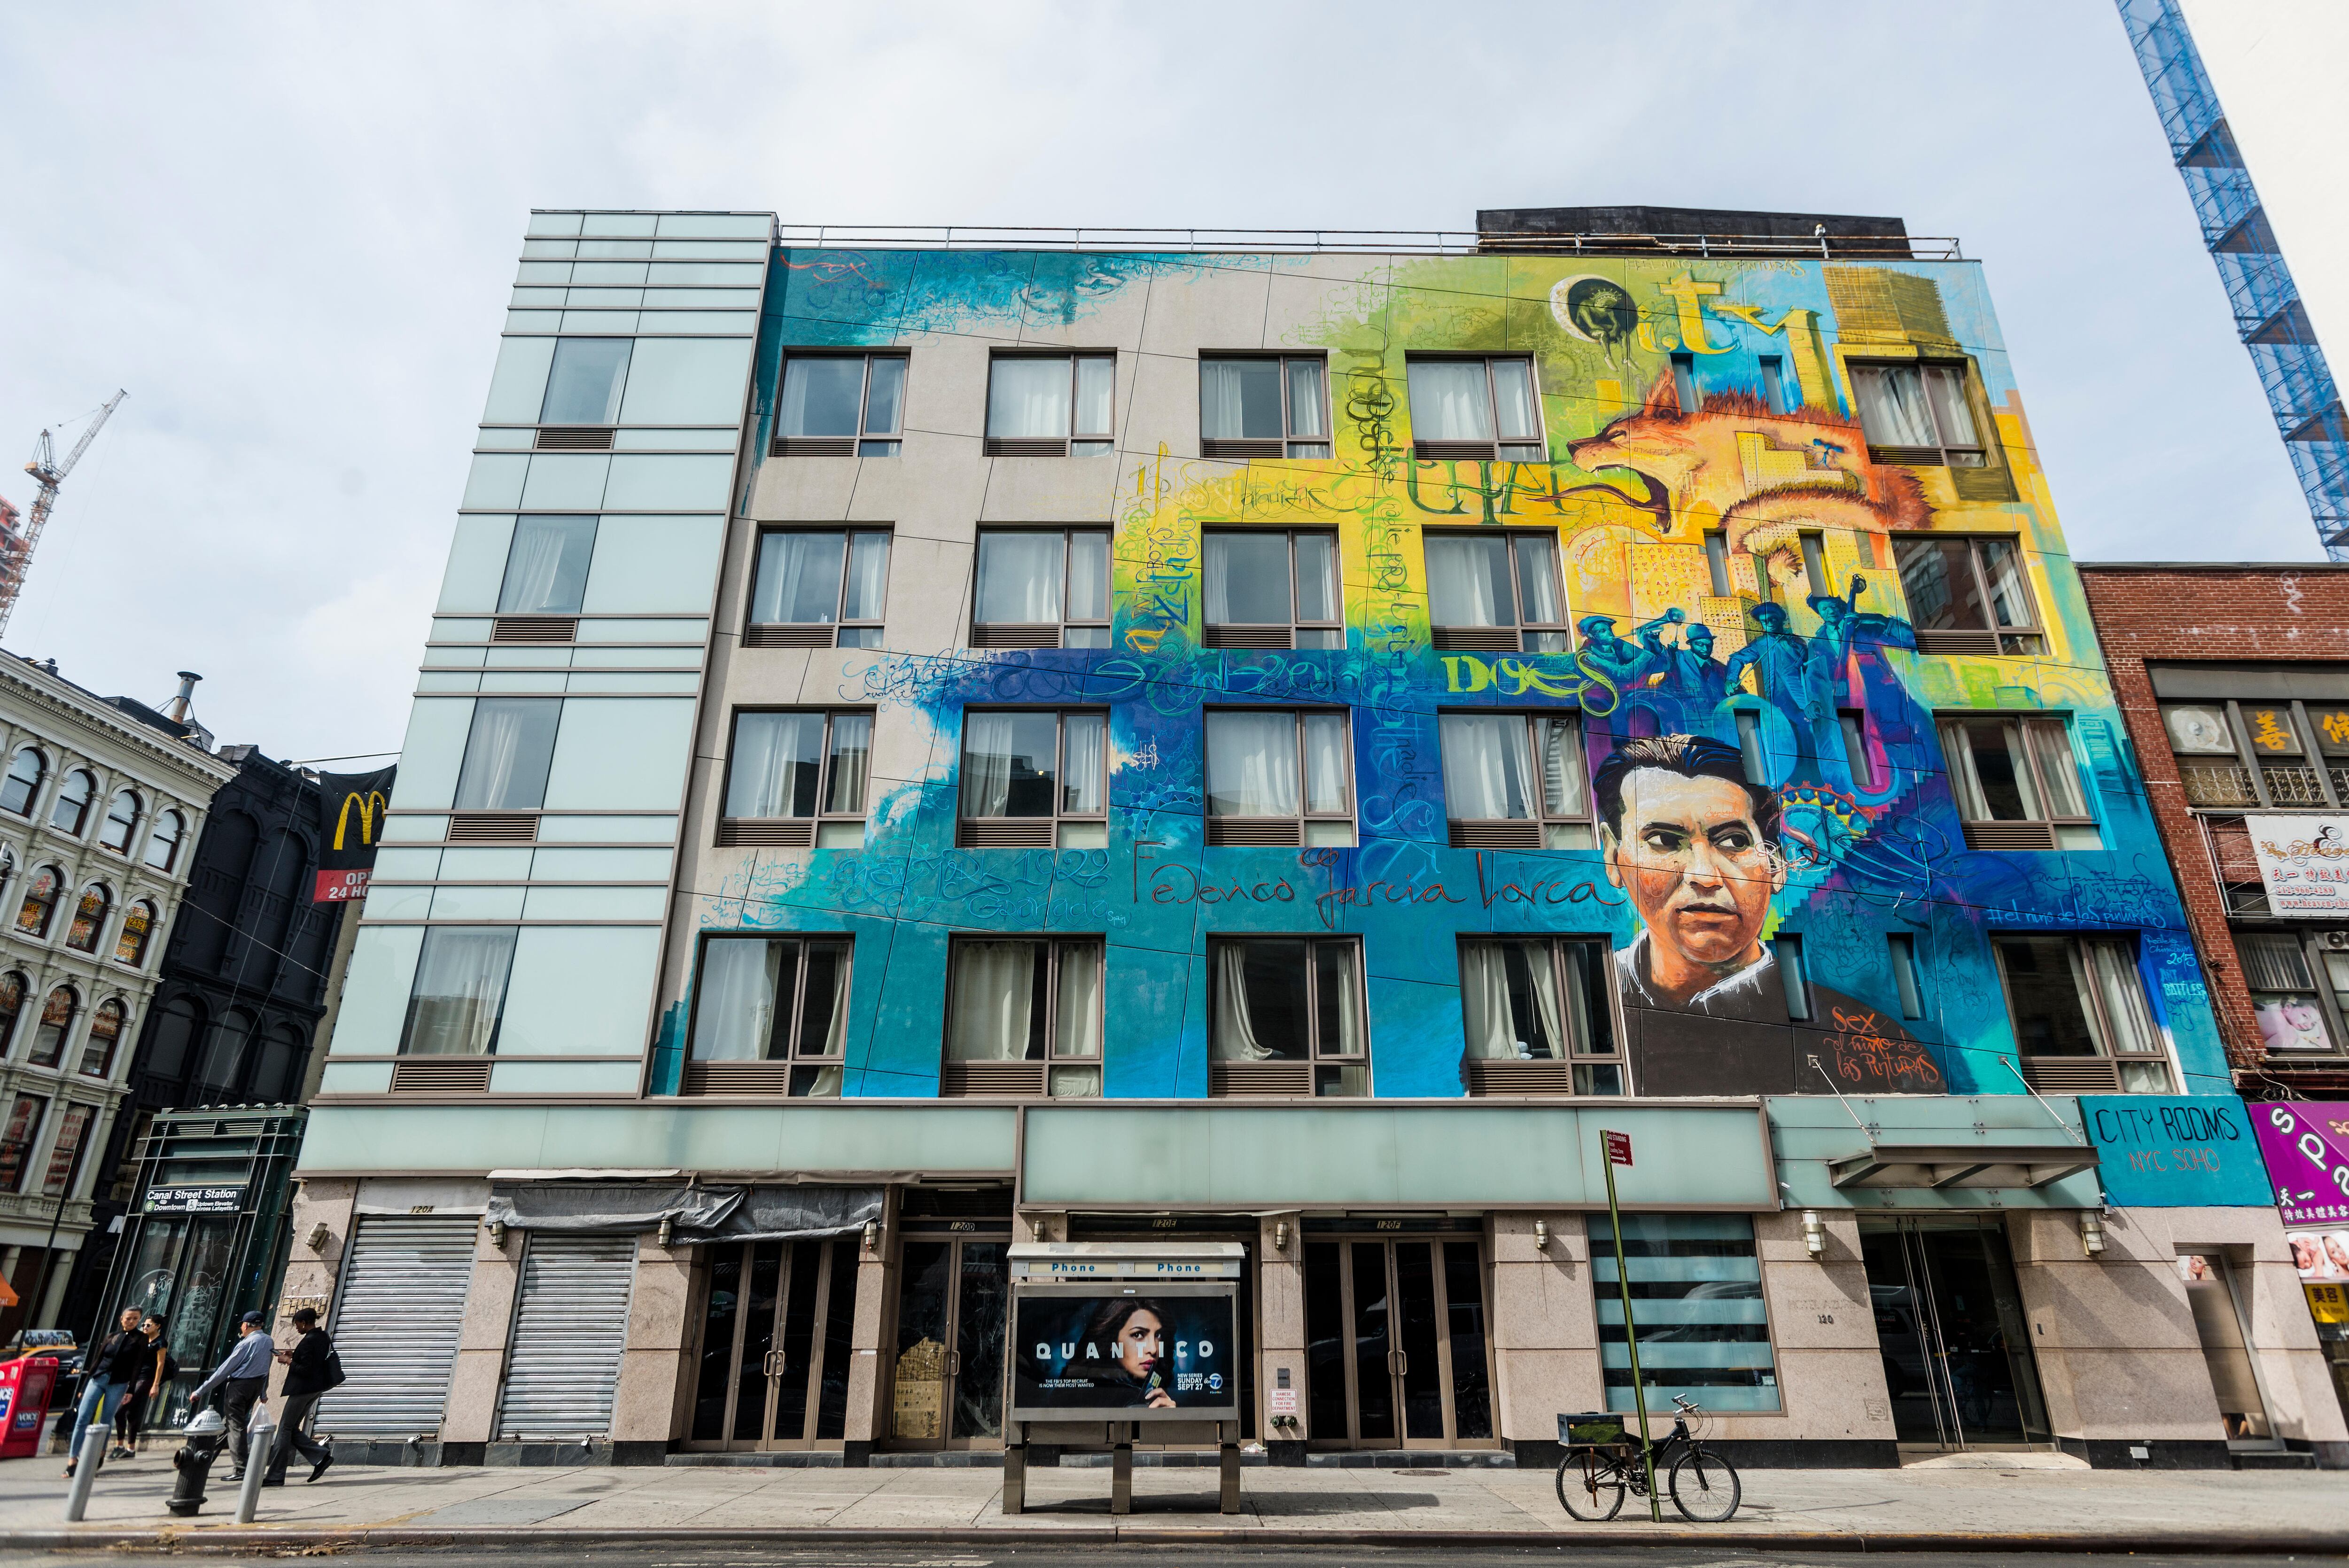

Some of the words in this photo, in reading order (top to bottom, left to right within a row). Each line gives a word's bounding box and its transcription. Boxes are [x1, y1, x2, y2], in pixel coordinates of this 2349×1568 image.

[2254, 709, 2290, 750] 善
[329, 886, 347, 899] 24
[125, 916, 147, 932] (212)
[122, 934, 137, 947] 966
[116, 946, 136, 959] 3649
[2166, 952, 2196, 971] 2015
[1898, 1029, 1922, 1053] de
[2095, 1108, 2155, 1144] CITY
[2159, 1105, 2240, 1143] ROOMS
[2128, 1150, 2167, 1172] NYC
[2172, 1148, 2220, 1172] SOHO
[147, 1191, 172, 1200] Canal
[174, 1190, 202, 1199] Street
[204, 1189, 237, 1198] Station
[2280, 1188, 2315, 1207] 天一
[952, 1222, 975, 1231] 120D
[1154, 1219, 1175, 1227] 120E
[1817, 1314, 1834, 1325] 120
[1036, 1340, 1213, 1359] QUANTICO
